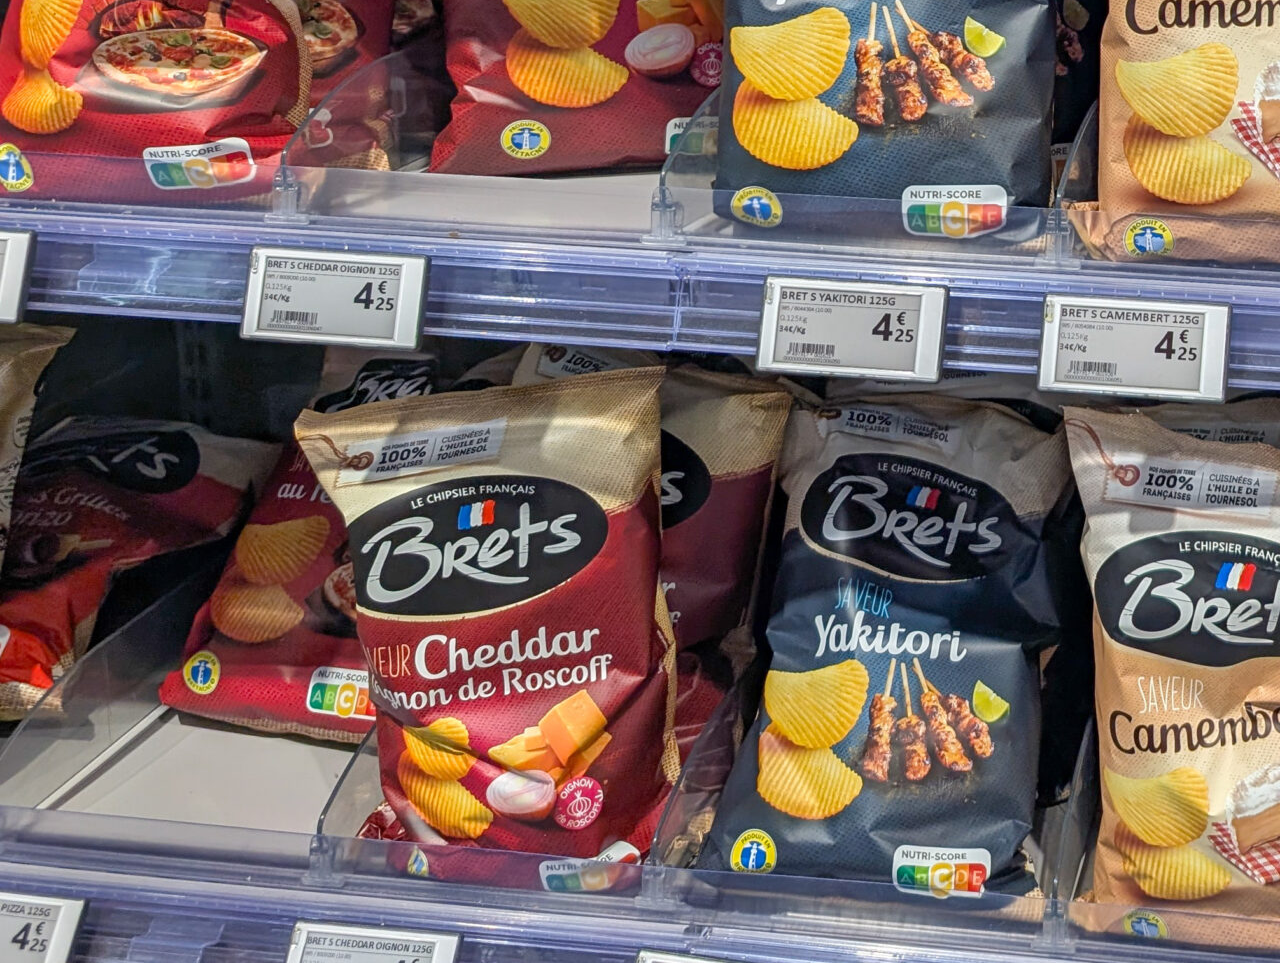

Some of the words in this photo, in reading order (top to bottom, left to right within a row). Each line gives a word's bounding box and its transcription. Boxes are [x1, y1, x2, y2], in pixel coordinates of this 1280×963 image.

[149, 144, 222, 160] NUTRI-SCORE
[910, 190, 981, 200] NUTRI-SCORE
[872, 313, 893, 342] 4
[894, 329, 914, 344] 25
[1145, 475, 1194, 492] 100%
[1209, 473, 1250, 486] CUISINÉES
[1252, 477, 1260, 487] À
[411, 497, 423, 509] LE
[426, 486, 476, 505] CHIPSIER
[479, 484, 535, 496] FRANÇAIS
[1142, 488, 1192, 502] FRANÇAISES
[1207, 484, 1241, 495] L'HUILE
[1244, 486, 1258, 496] DE
[1205, 495, 1258, 508] TOURNESOL
[823, 476, 1001, 568] Brets
[362, 502, 581, 603] Brets
[1179, 542, 1191, 552] LE
[1194, 542, 1242, 555] CHIPSIER
[835, 577, 892, 618] SAVEUR
[814, 610, 967, 662] Yakitori
[414, 625, 600, 680] Cheddar
[1137, 676, 1204, 714] SAVEUR
[902, 850, 967, 861] NUTRI-SCORE
[1, 904, 26, 915] PIZZA
[27, 905, 51, 917] 125G
[11, 923, 29, 951] 4
[29, 938, 47, 953] 25
